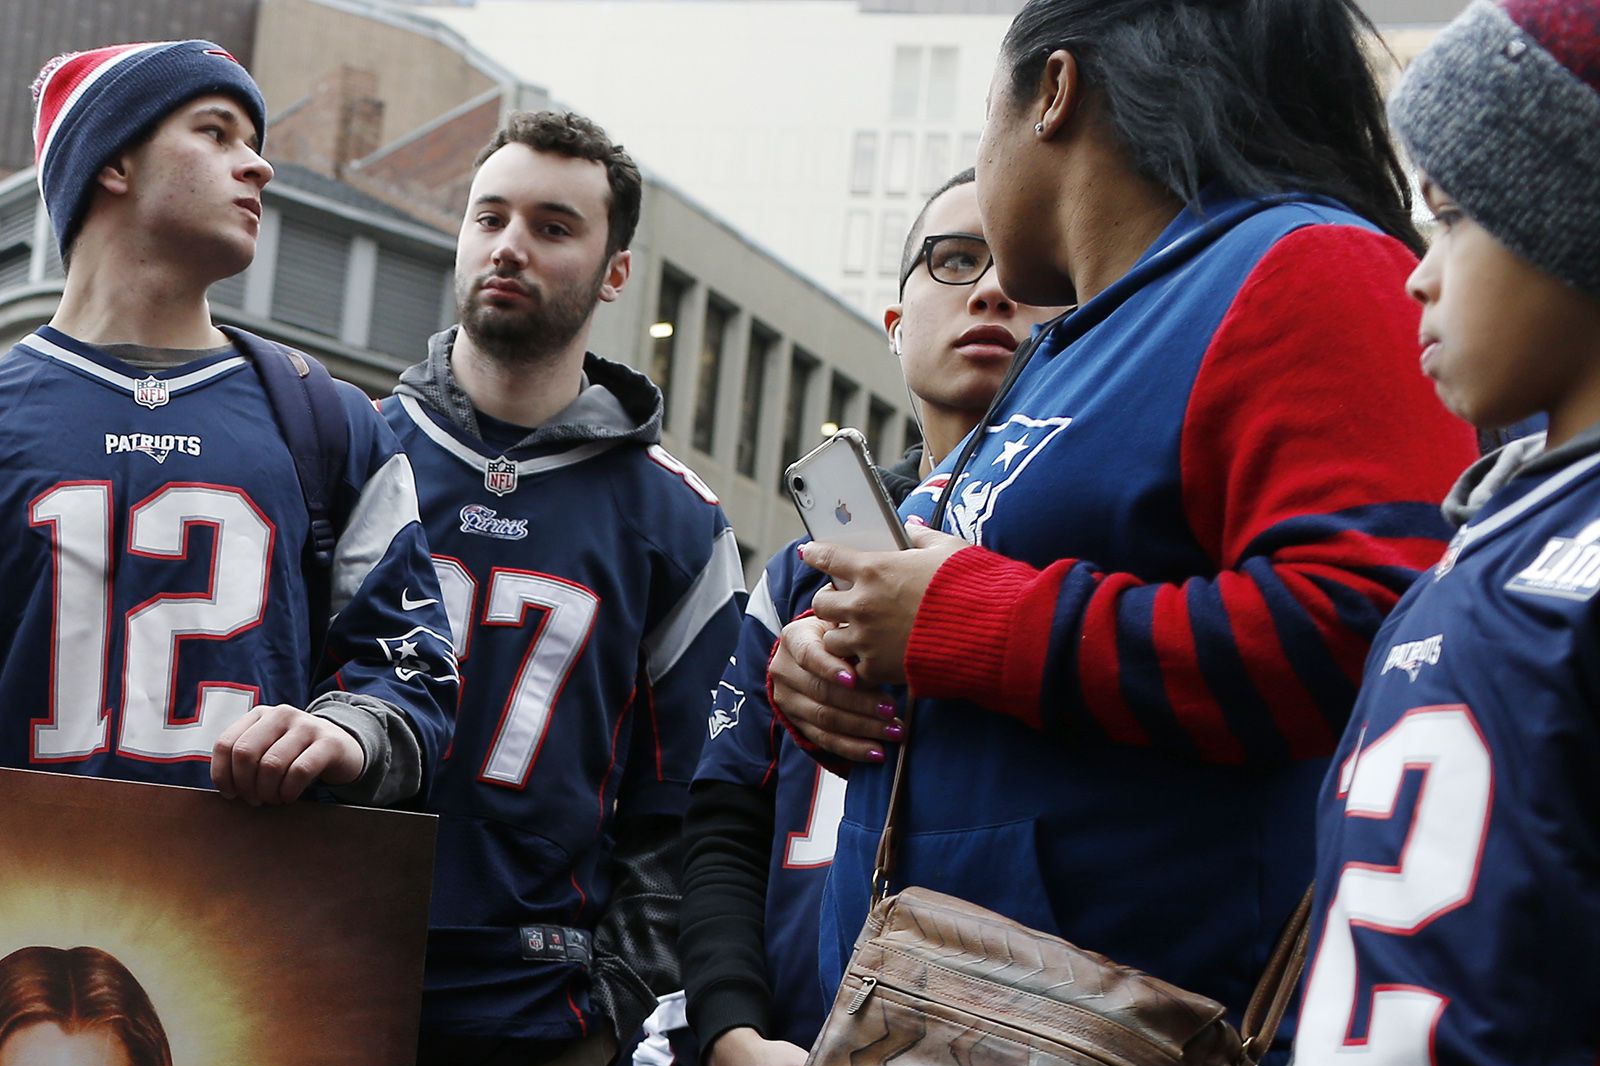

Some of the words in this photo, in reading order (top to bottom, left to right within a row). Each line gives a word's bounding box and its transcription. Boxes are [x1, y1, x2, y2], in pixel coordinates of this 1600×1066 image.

[140, 387, 165, 401] NFL
[104, 432, 202, 457] PATRIOTS
[490, 473, 513, 489] NFL
[28, 479, 277, 764] 12
